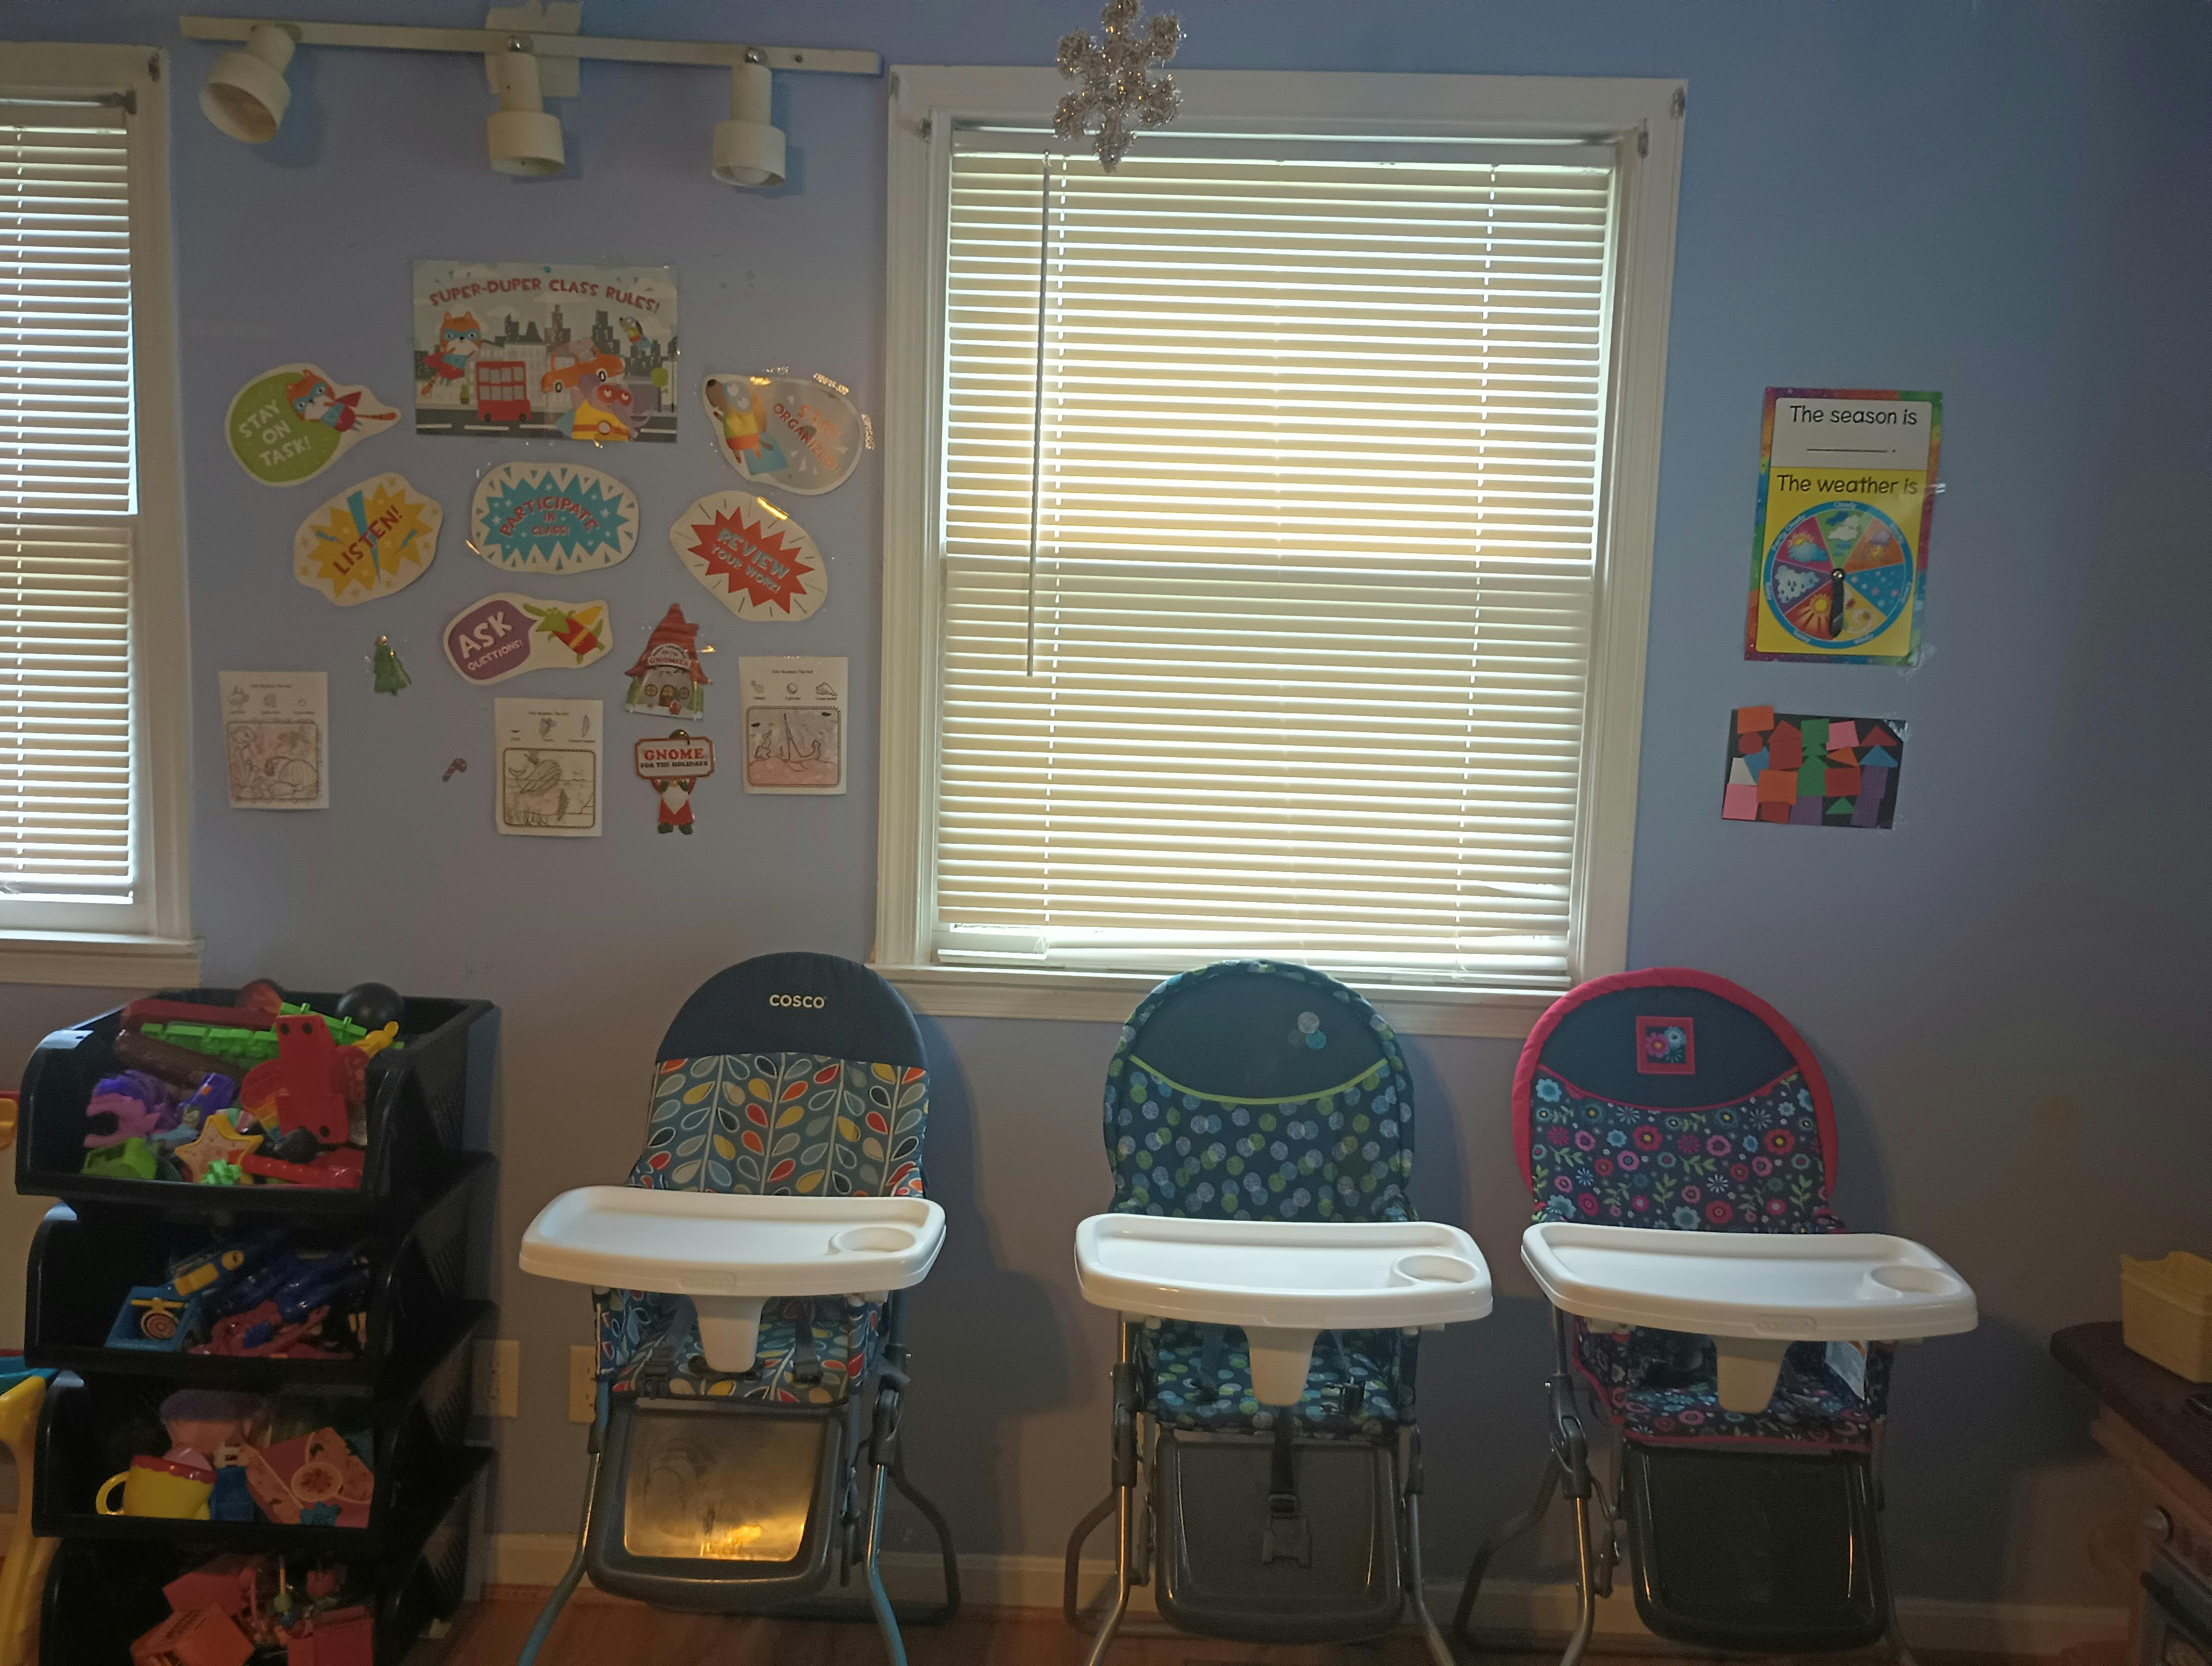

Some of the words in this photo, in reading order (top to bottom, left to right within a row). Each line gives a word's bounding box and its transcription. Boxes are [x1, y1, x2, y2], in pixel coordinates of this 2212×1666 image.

[430, 278, 542, 306] SUPER-DUPER
[548, 279, 599, 297] CLASS
[606, 285, 660, 313] RULES!
[239, 399, 280, 439] STAY
[798, 403, 842, 436] STAY
[1791, 405, 1825, 424] The
[1830, 410, 1896, 425] season
[1903, 408, 1918, 425] is
[262, 420, 291, 445] ON
[258, 435, 312, 467] TASK!
[1777, 475, 1811, 492] The
[1817, 475, 1898, 495] weather
[1903, 478, 1918, 495] is
[500, 495, 599, 537] PARTICIPATE
[544, 513, 556, 522] IN
[333, 504, 403, 575] LISTEN!
[717, 527, 790, 580] REVIEW
[711, 544, 743, 569] YOUR
[745, 565, 781, 594] WORK!
[458, 611, 512, 659] ASK
[644, 748, 704, 761] GNOME
[769, 994, 825, 1009] COSCO
